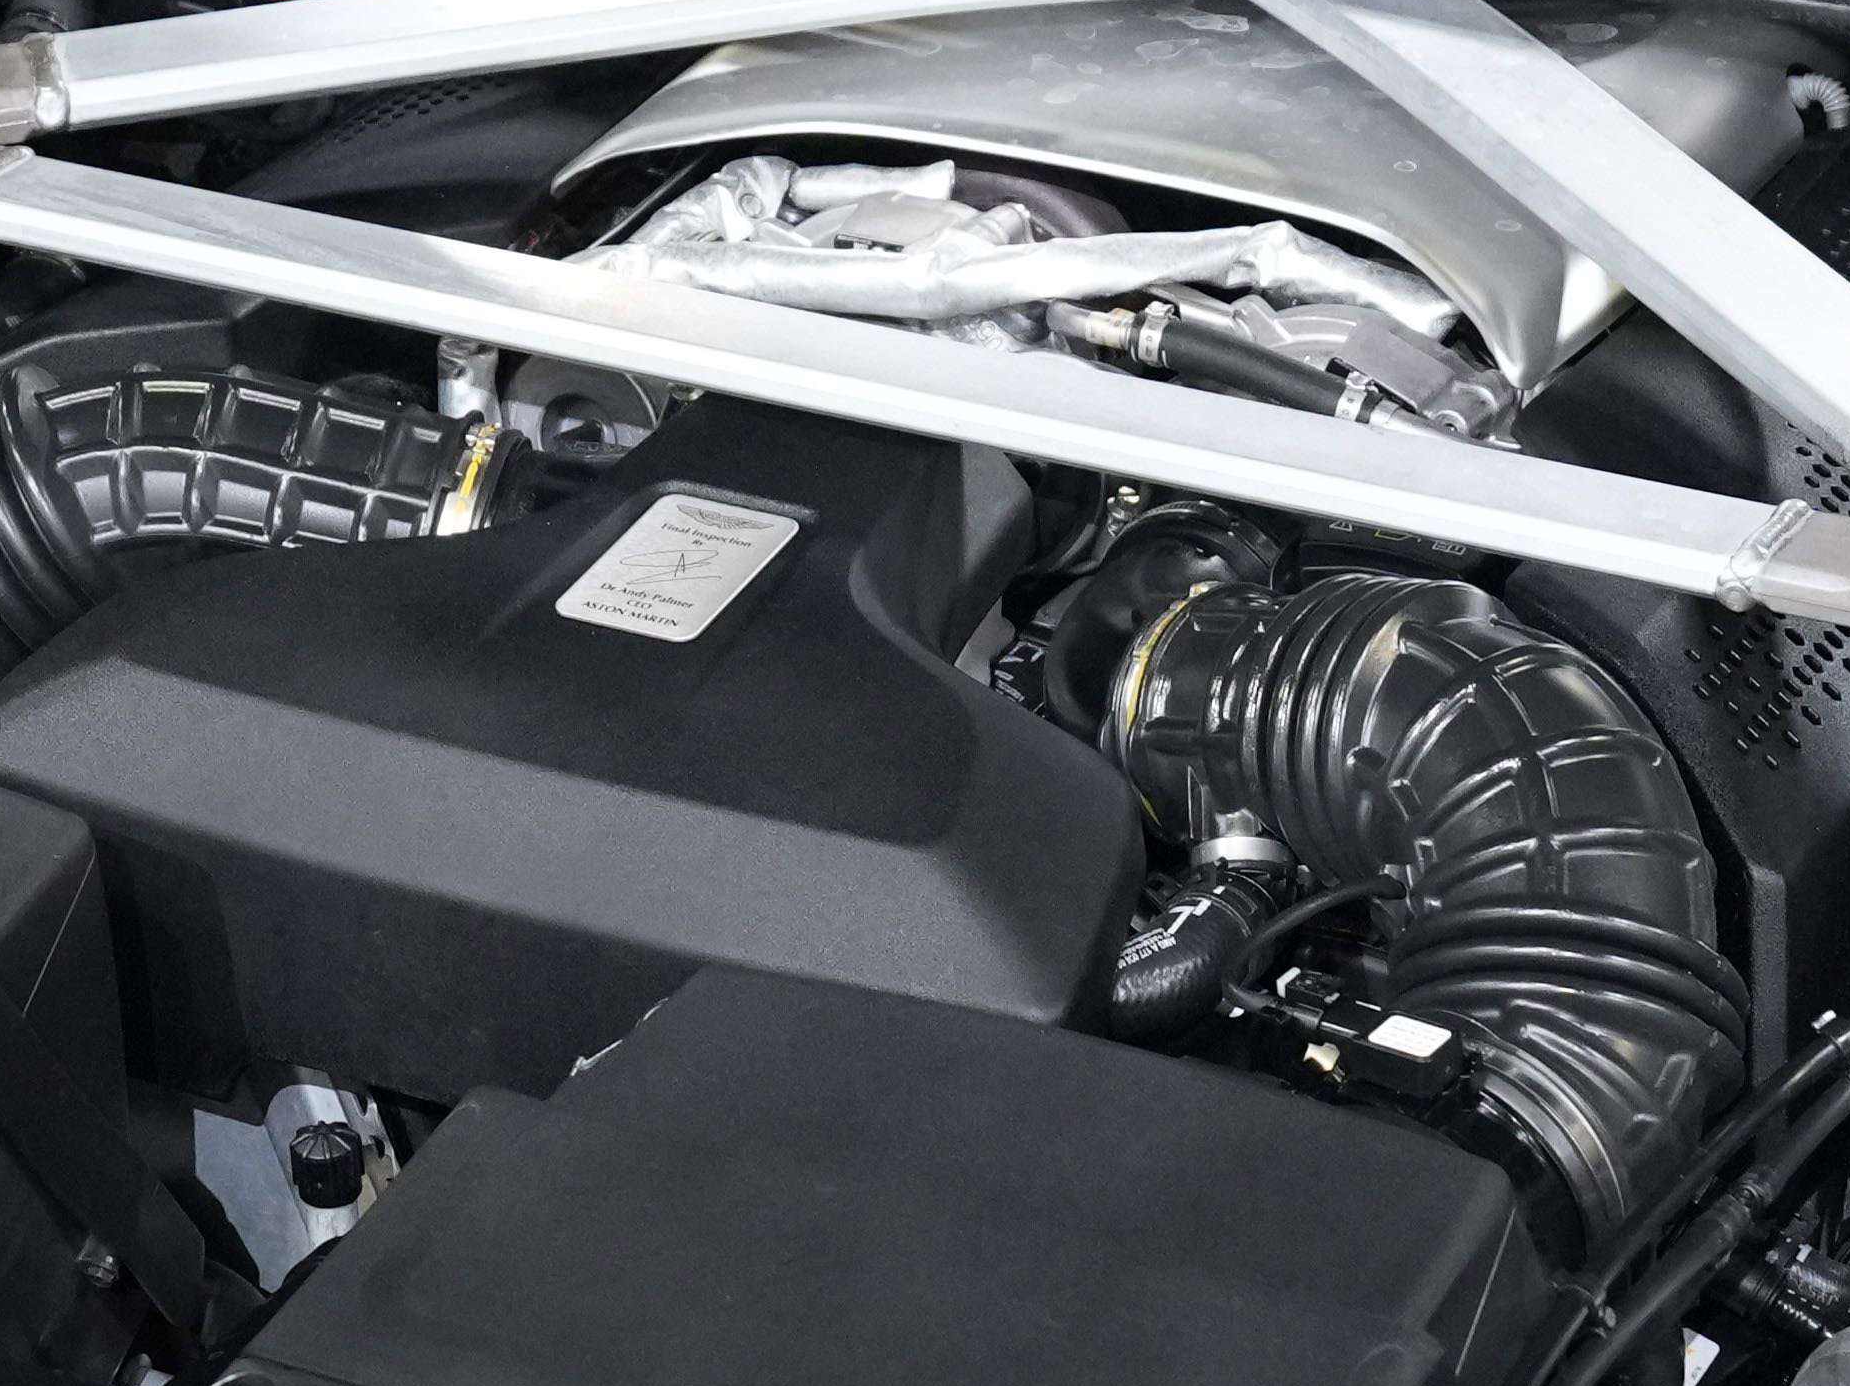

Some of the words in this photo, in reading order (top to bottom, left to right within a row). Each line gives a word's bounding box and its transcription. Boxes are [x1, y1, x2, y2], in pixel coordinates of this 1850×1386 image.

[661, 523, 691, 534] Final
[692, 529, 752, 548] Inspection
[600, 582, 616, 591] Dr
[617, 586, 649, 600] Andy
[651, 593, 695, 609] Palmer
[626, 599, 652, 609] CEO
[581, 600, 627, 615] ASTON
[628, 611, 680, 627] MARTIN
